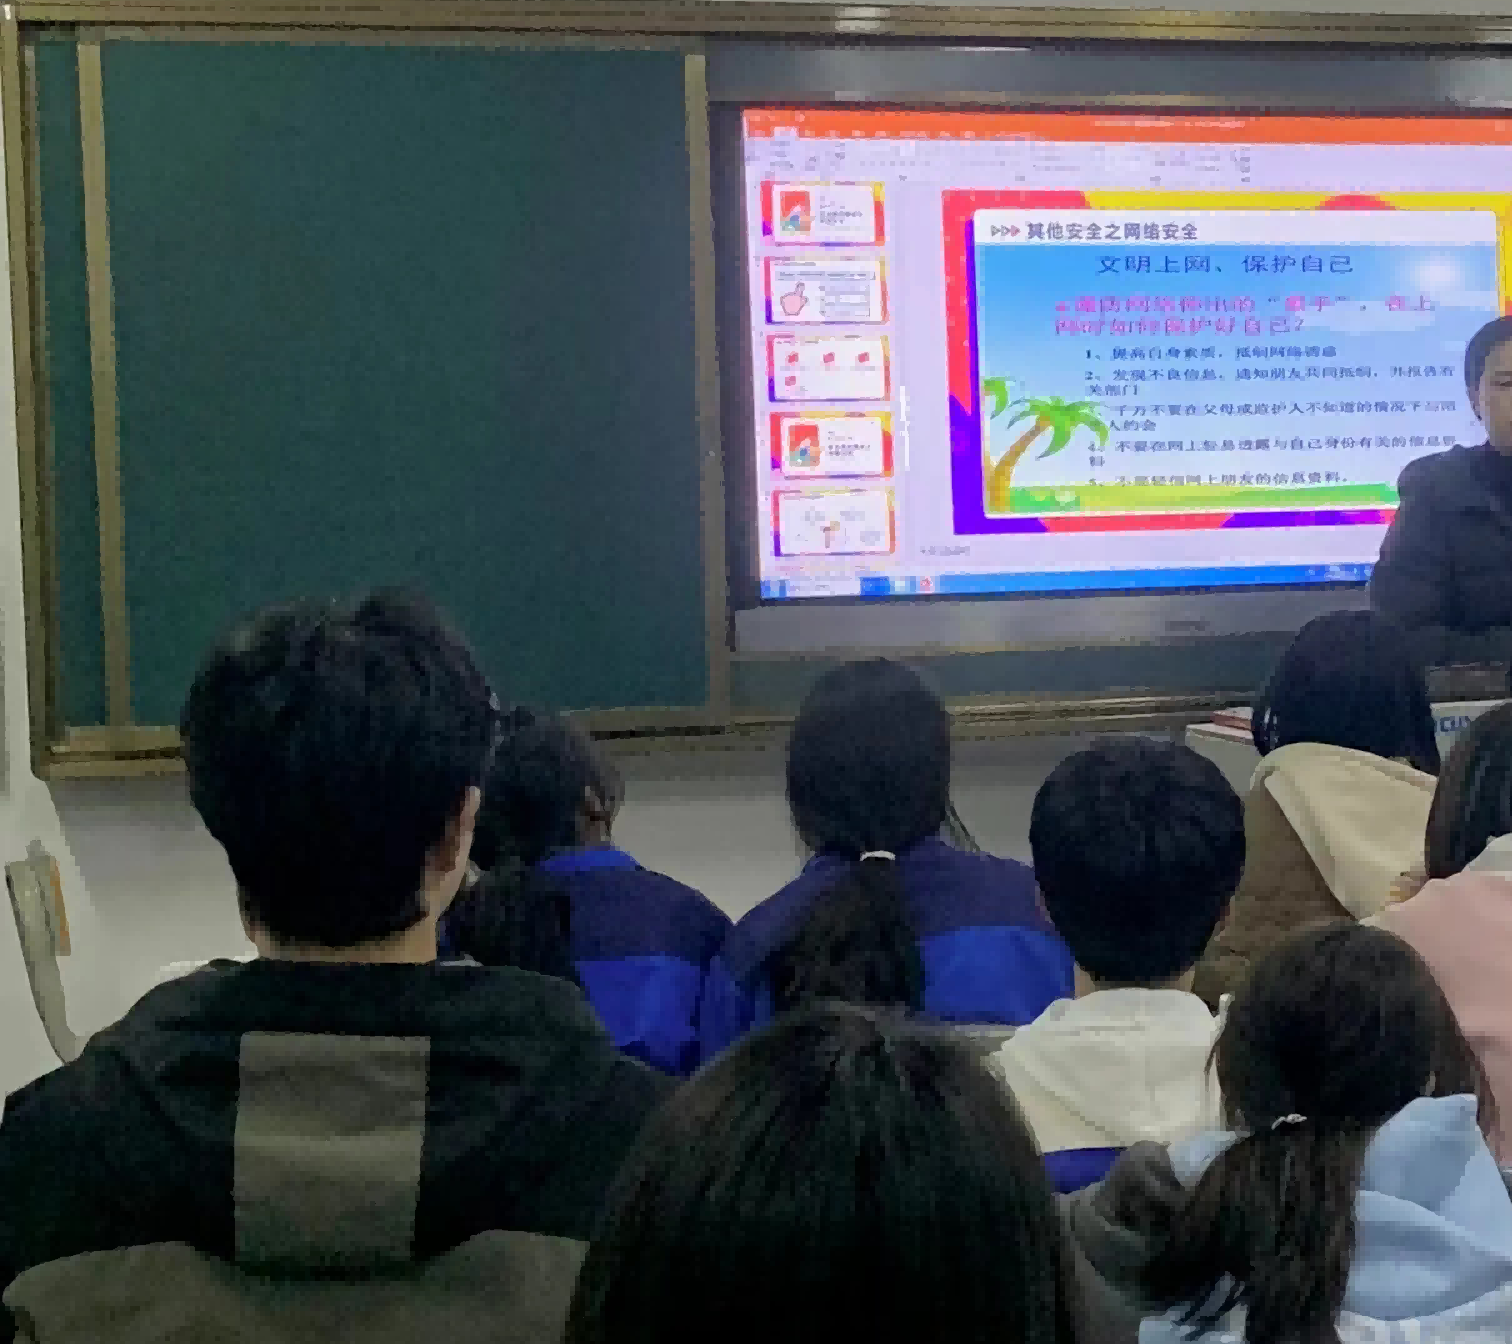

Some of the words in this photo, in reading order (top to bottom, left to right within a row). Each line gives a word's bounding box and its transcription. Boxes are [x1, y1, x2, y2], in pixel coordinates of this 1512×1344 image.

[1027, 221, 1199, 241] 其他安全之网络安全
[1097, 254, 1353, 274] 文明上网、保护自己
